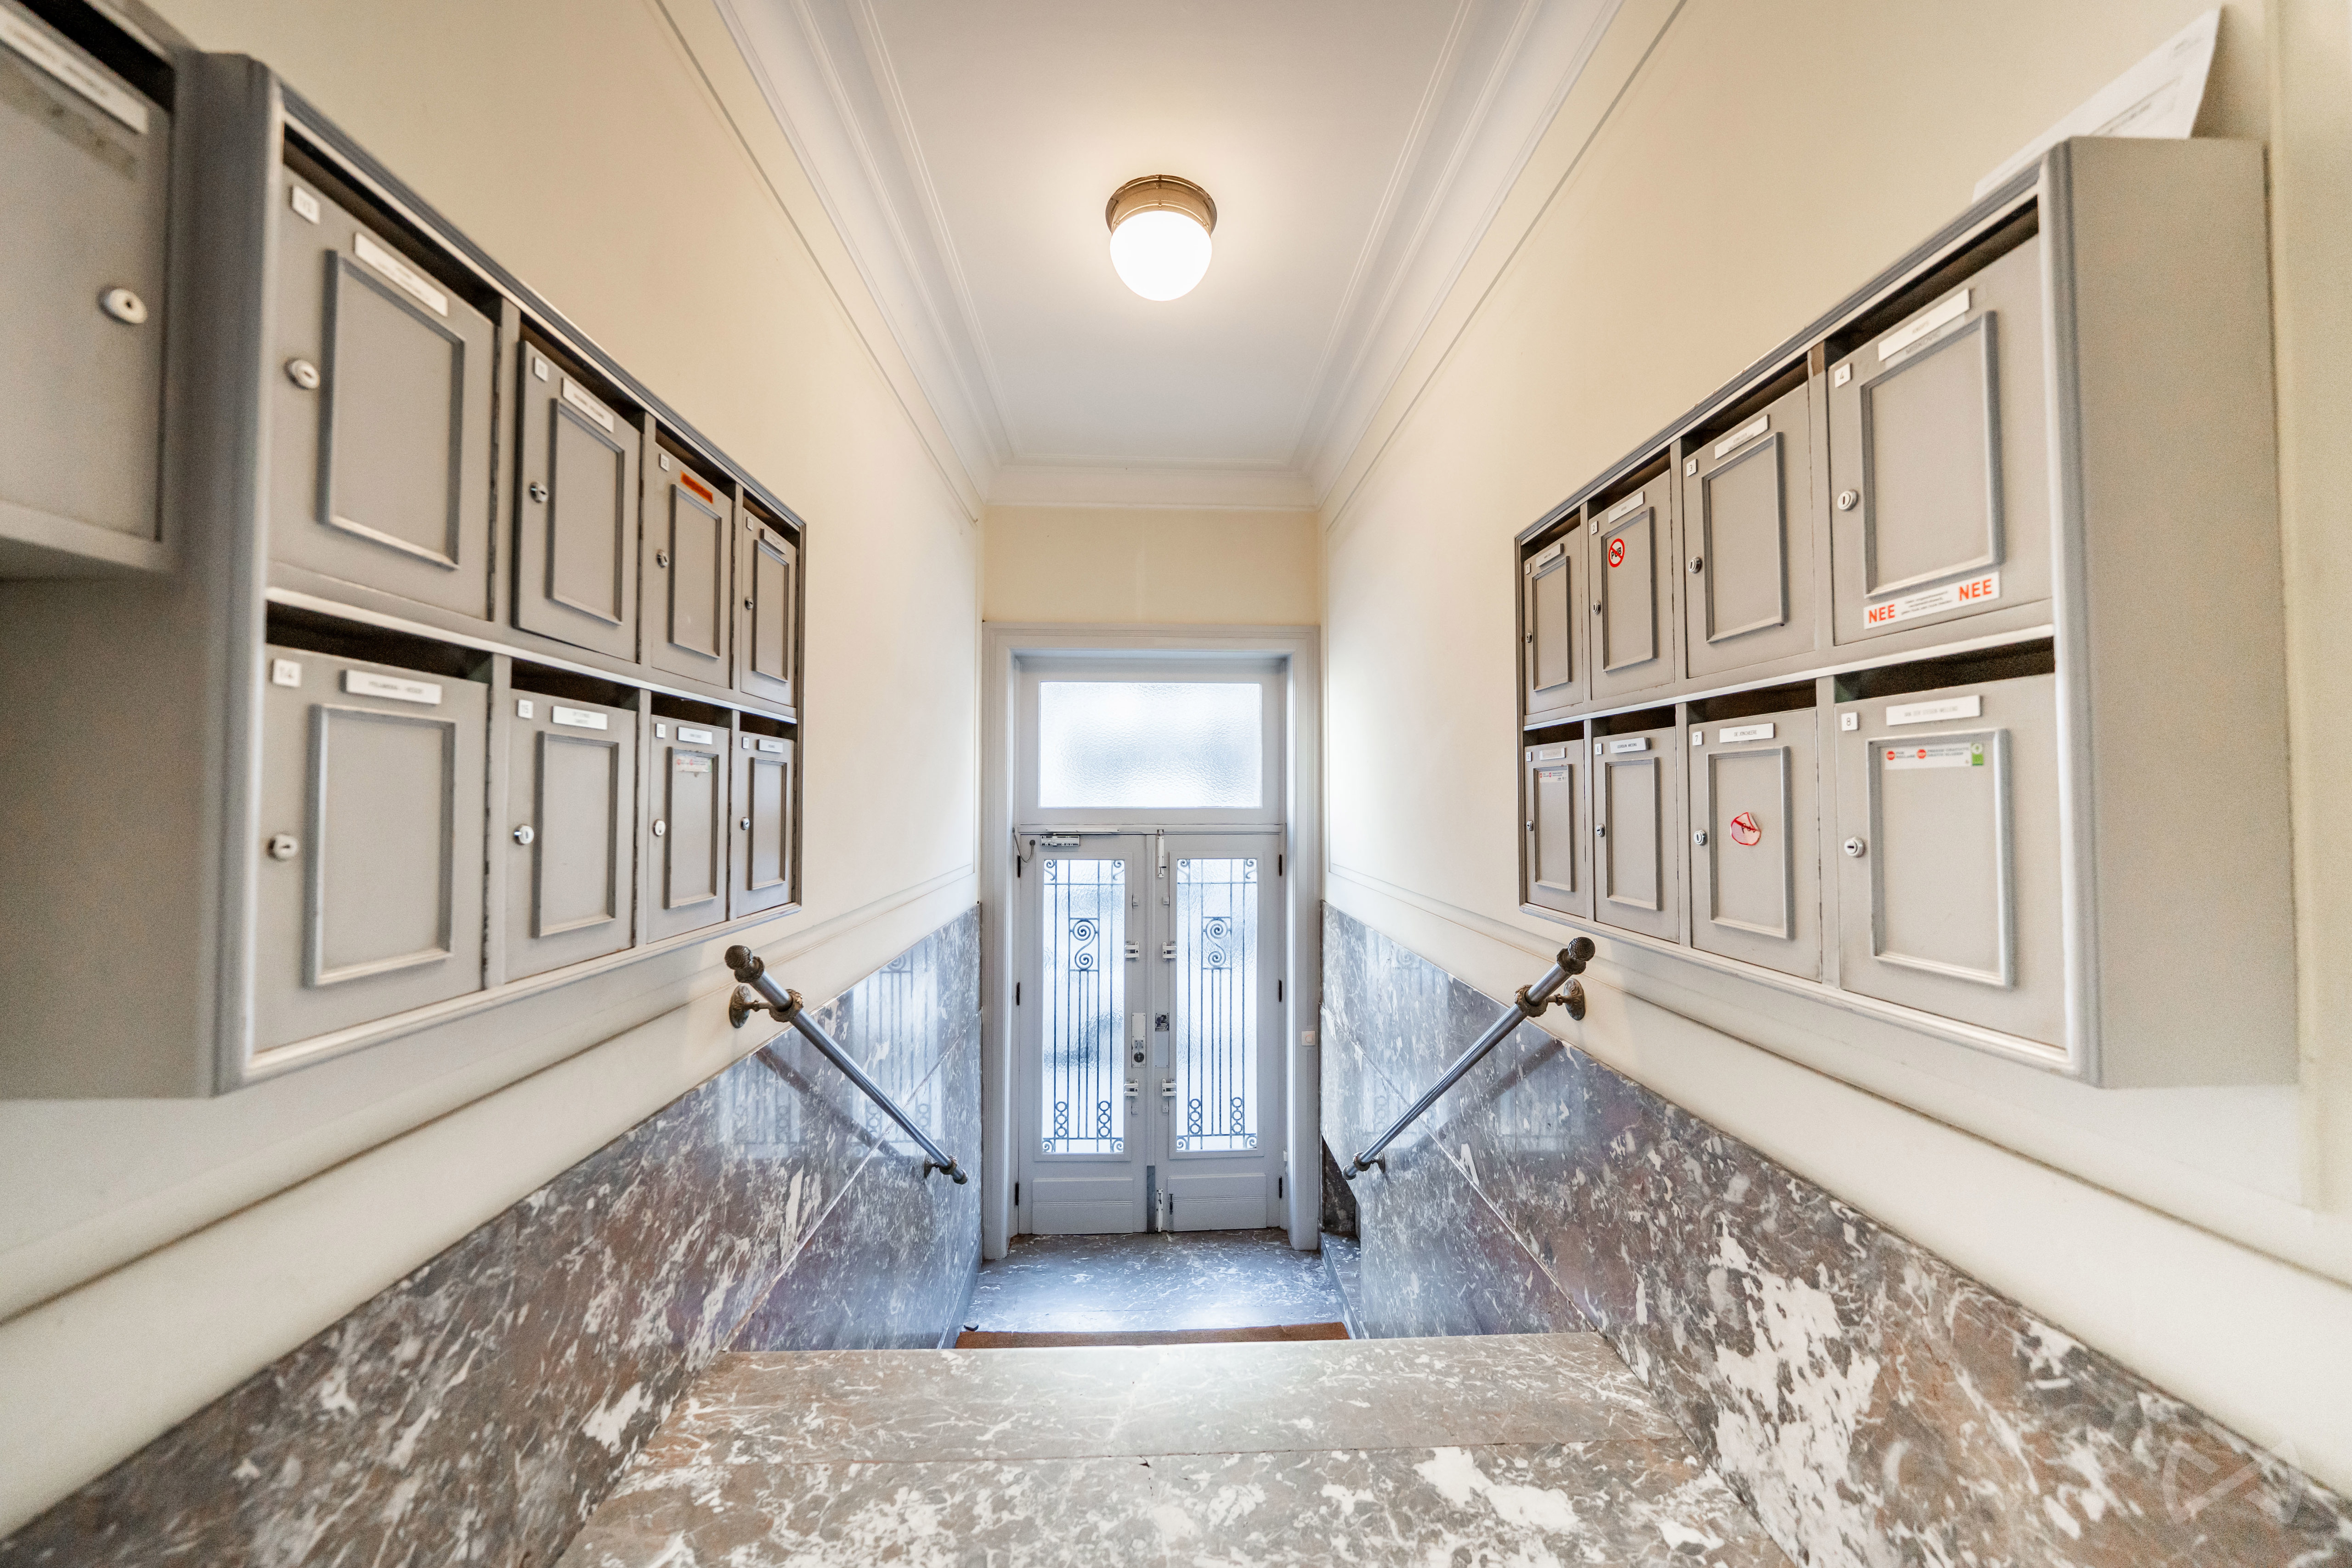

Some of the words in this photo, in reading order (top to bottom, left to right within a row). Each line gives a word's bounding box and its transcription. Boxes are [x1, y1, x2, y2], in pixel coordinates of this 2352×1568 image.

[1839, 371, 1844, 380] 4
[1611, 547, 1622, 560] PUB
[1868, 604, 1896, 624] NEE
[1959, 578, 1992, 601] NEE
[1846, 717, 1851, 726] 8
